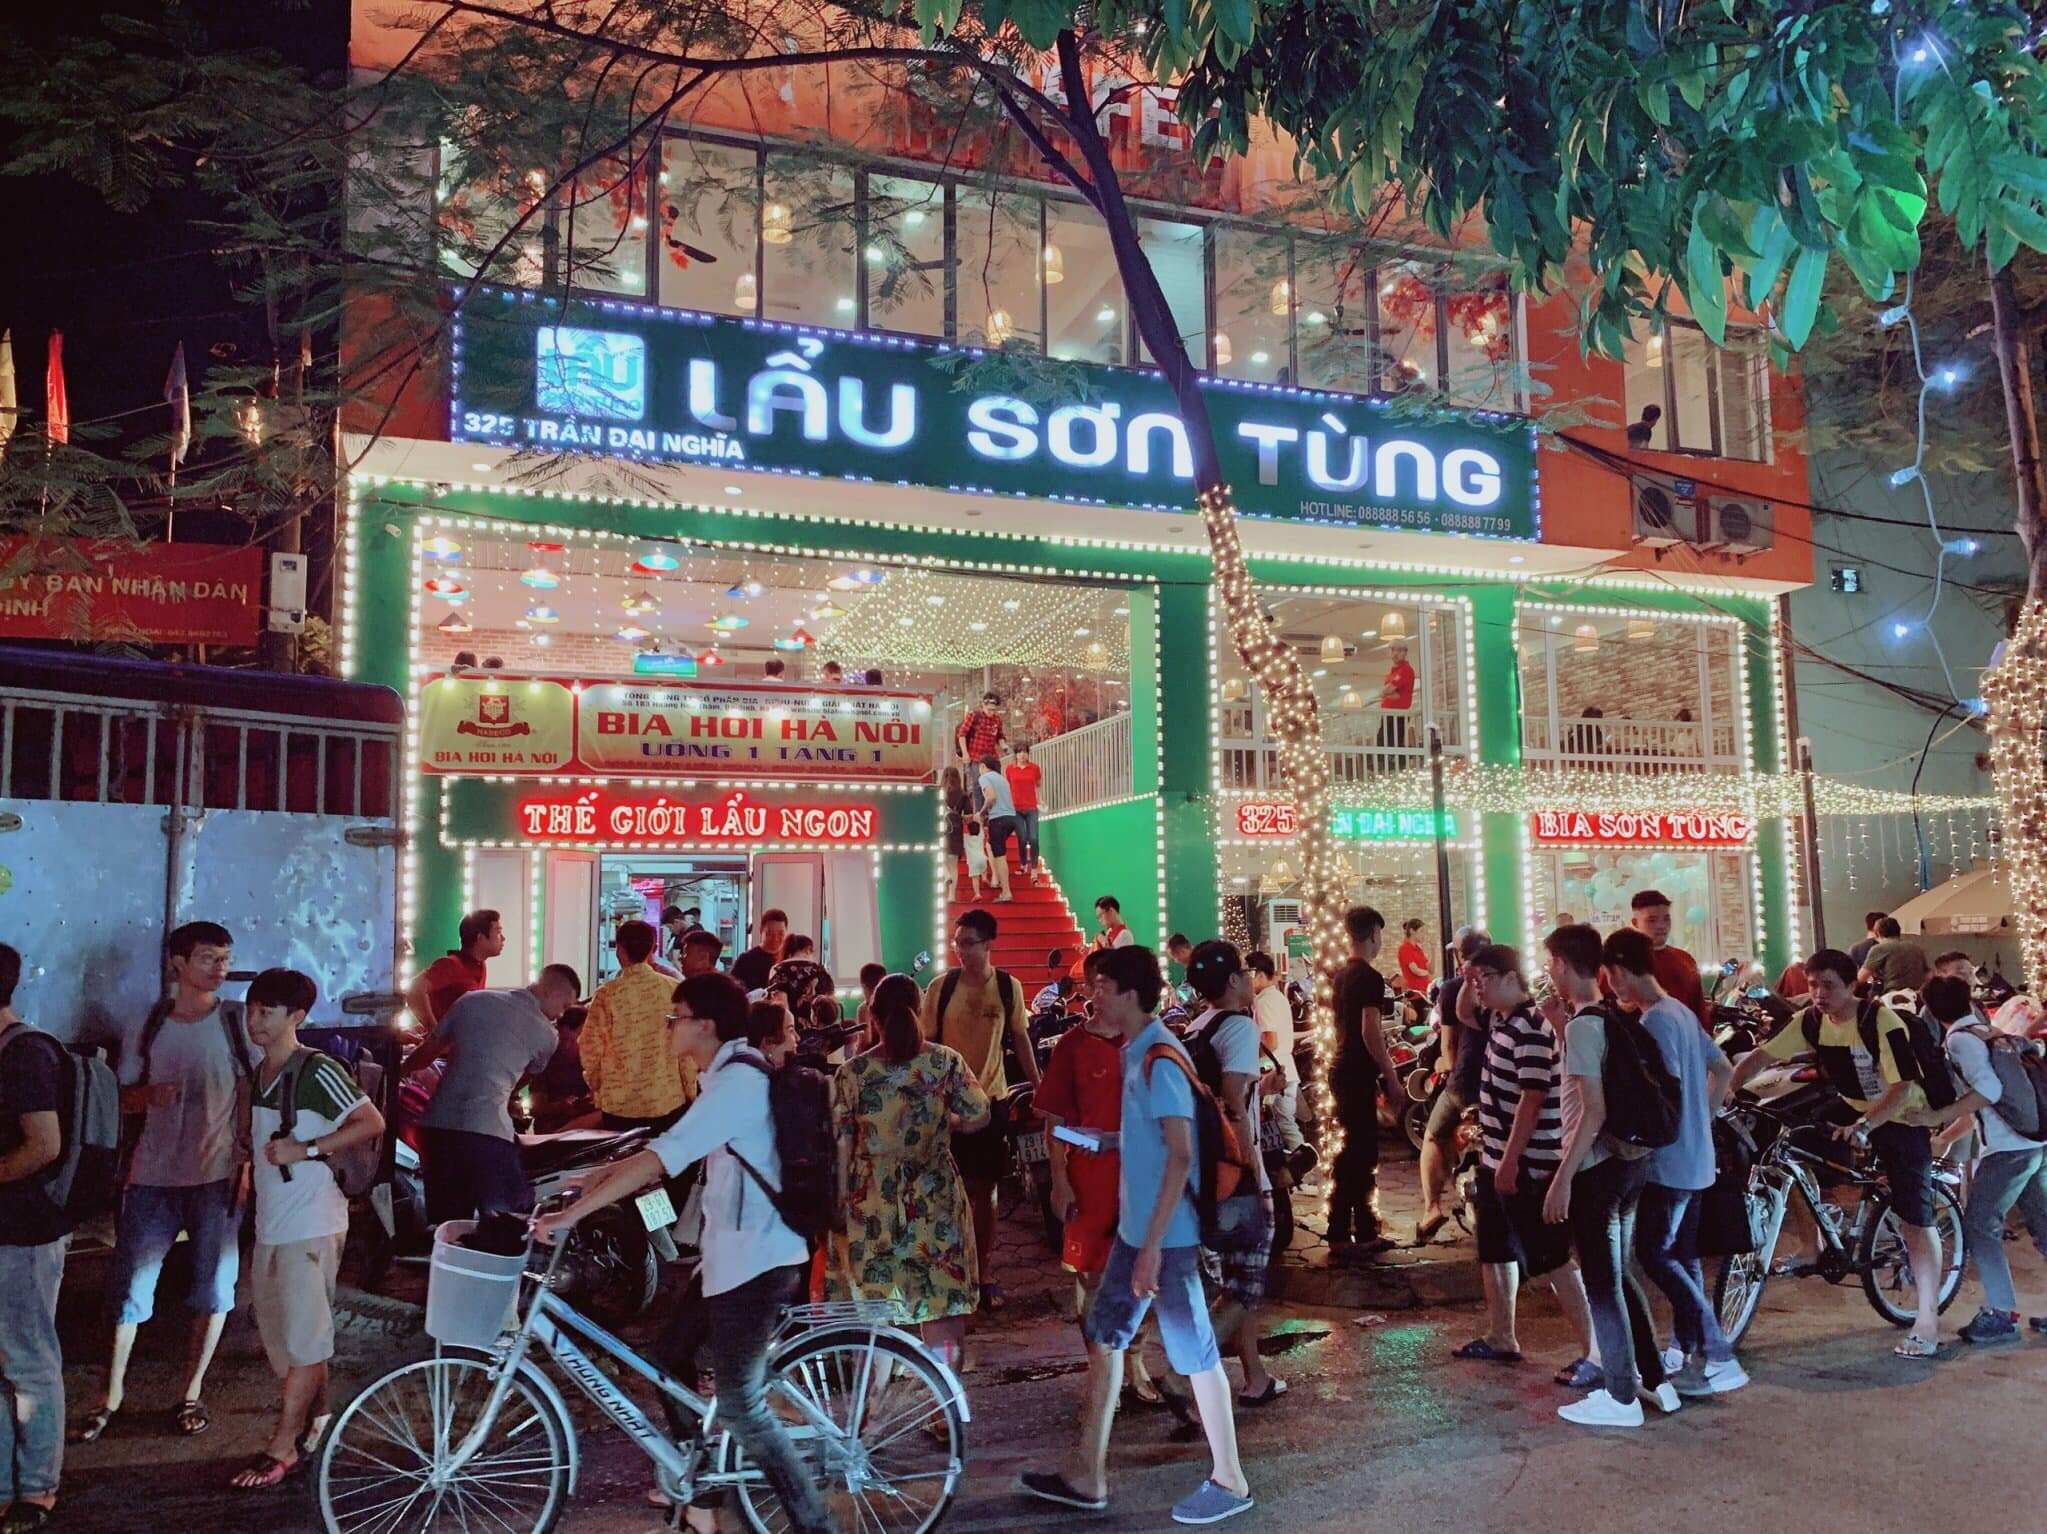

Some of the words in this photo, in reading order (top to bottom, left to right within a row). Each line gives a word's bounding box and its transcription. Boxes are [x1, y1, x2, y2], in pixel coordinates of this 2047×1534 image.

[690, 337, 916, 447] LẨU
[662, 433, 745, 461] NGHĨA
[46, 574, 102, 593] BAN
[193, 578, 248, 600] DÂN
[598, 711, 673, 736] BIA
[781, 715, 838, 742] HÀ
[855, 718, 920, 748] NỘI
[435, 751, 462, 763] BIA
[749, 746, 758, 759] 1
[872, 749, 881, 763] 1
[524, 792, 598, 834] THẾ
[611, 798, 686, 836] GIỚI
[700, 793, 767, 837] LẨU
[780, 808, 872, 837] NGON
[1241, 804, 1296, 834] 325
[1538, 811, 1595, 838] BIA
